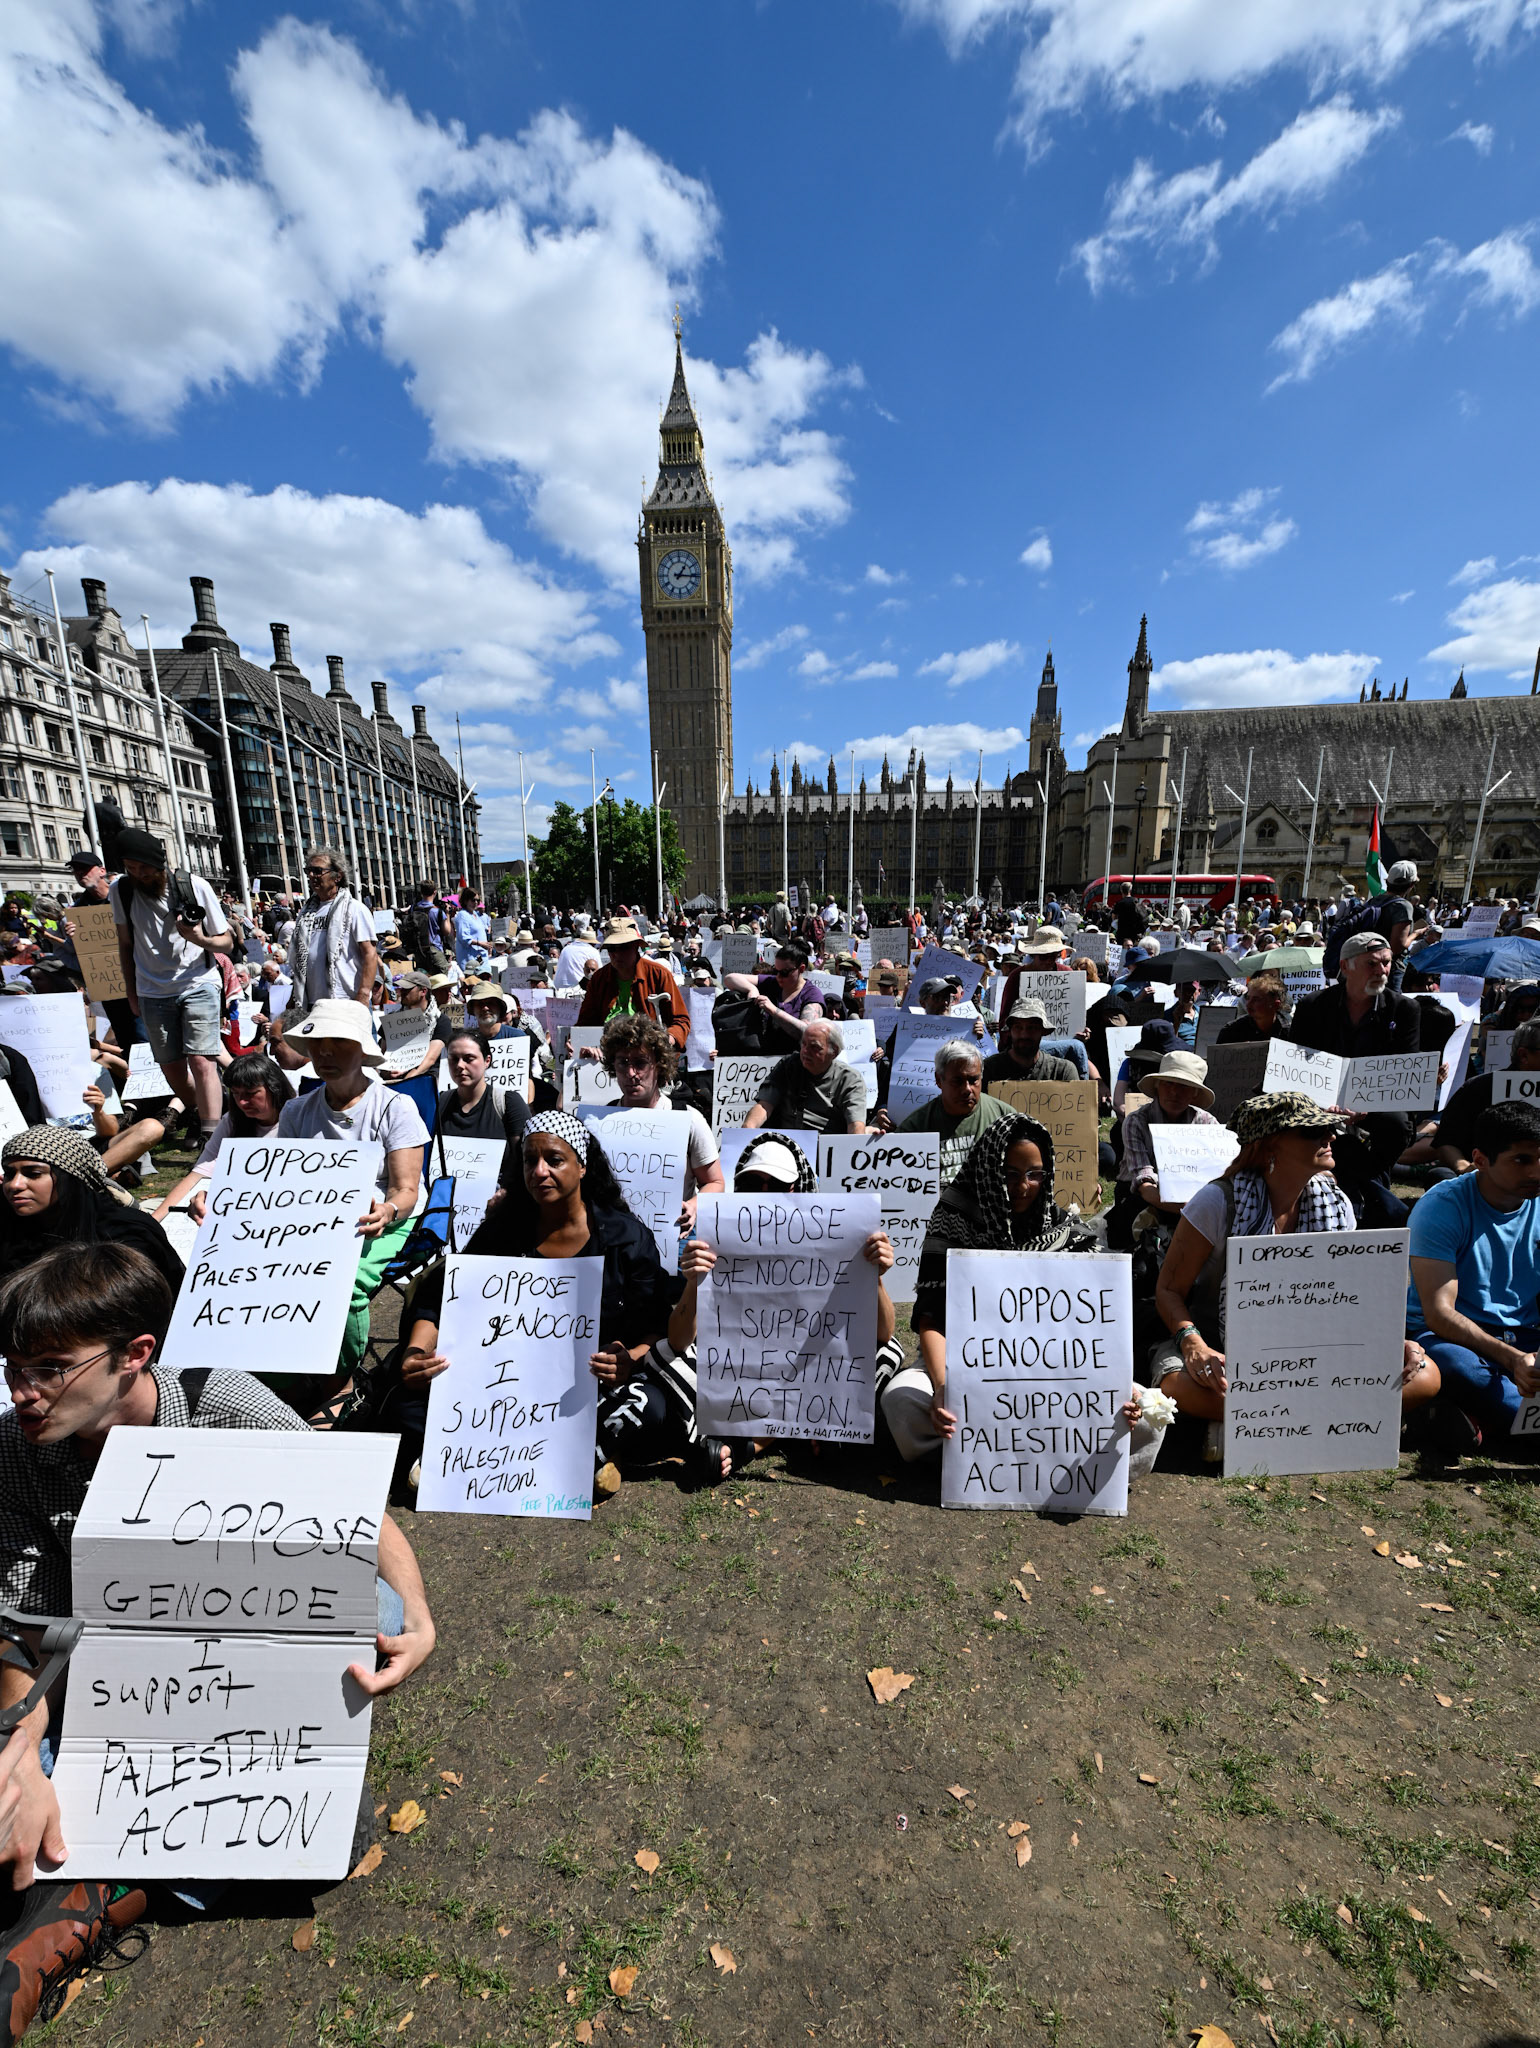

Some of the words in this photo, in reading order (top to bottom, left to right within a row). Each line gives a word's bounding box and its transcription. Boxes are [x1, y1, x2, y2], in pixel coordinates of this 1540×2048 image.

[76, 915, 83, 927] I
[92, 913, 114, 925] OPP
[79, 929, 119, 942] GENO
[90, 957, 95, 969] I
[1027, 976, 1032, 988] I
[1038, 974, 1070, 986] OPPOSE
[1025, 988, 1070, 1000] GENOCIDE
[901, 1020, 908, 1030] I
[1489, 1035, 1499, 1047] I
[134, 1045, 147, 1060] I
[1286, 1049, 1335, 1069] OPPOSE
[491, 1058, 526, 1070] CIDE
[717, 1062, 723, 1083] I
[726, 1062, 770, 1083] OPPO
[899, 1062, 907, 1072] I
[1365, 1055, 1438, 1073] SUPPORT
[570, 1065, 582, 1102] I
[1266, 1062, 1334, 1091] GENOCIDE
[1351, 1071, 1436, 1091] PALESTINE
[717, 1085, 759, 1106] GENO
[1352, 1087, 1421, 1104] ACTION
[1505, 1079, 1512, 1099] I
[1010, 1091, 1085, 1114] OPPOSE
[717, 1109, 721, 1126] I
[601, 1119, 666, 1140] OPPOSE
[1209, 1128, 1235, 1138] GENO
[826, 1146, 834, 1178] I
[851, 1147, 940, 1171] OPPOSE
[1168, 1146, 1208, 1156] SUPPORT
[227, 1147, 235, 1176] I
[244, 1147, 359, 1182] OPPOSE
[606, 1150, 679, 1180] NOCIDE
[841, 1176, 938, 1196] GENOCIDE
[212, 1187, 361, 1217] GENOCIDE
[621, 1189, 672, 1210] PORT
[210, 1223, 219, 1242] I
[715, 1201, 719, 1244] I
[737, 1204, 846, 1246] OPPOSE
[1238, 1247, 1242, 1265] I
[1252, 1245, 1315, 1262] OPPOSE
[1327, 1242, 1404, 1259] GENOCIDE
[190, 1261, 332, 1293] PALESTINE
[712, 1256, 852, 1294] GENOCIDE
[446, 1267, 460, 1303] I
[482, 1270, 577, 1306] OPPOSE
[193, 1298, 321, 1327] ACTION
[972, 1285, 977, 1322] I
[999, 1286, 1116, 1324] OPPOSE
[717, 1305, 721, 1337] I
[741, 1308, 857, 1341] SUPPORT
[962, 1336, 1109, 1369] GENOCIDE
[485, 1360, 519, 1389] I
[707, 1347, 866, 1384] PALESTINE
[1235, 1362, 1239, 1379] I
[1250, 1357, 1318, 1376] SUPPORT
[1230, 1376, 1319, 1393] PALESTINE
[1331, 1374, 1390, 1387] ACTION
[442, 1396, 561, 1437] SUPPORT
[964, 1394, 968, 1423] I
[993, 1390, 1119, 1420] SUPPORT
[764, 1424, 786, 1435] THIS
[813, 1428, 861, 1439] HAITHAM
[960, 1426, 1116, 1455] PALESTINE
[1235, 1424, 1313, 1440] PALESTINE
[1327, 1420, 1382, 1436] ACTION
[963, 1462, 1099, 1495] ACTION
[122, 1453, 175, 1524] I
[172, 1500, 377, 1565] OPPOSE
[103, 1580, 339, 1620] GENOCIDE
[189, 1638, 225, 1673] I
[96, 1725, 322, 1815] PALESTINE
[118, 1790, 332, 1858] ACTION
